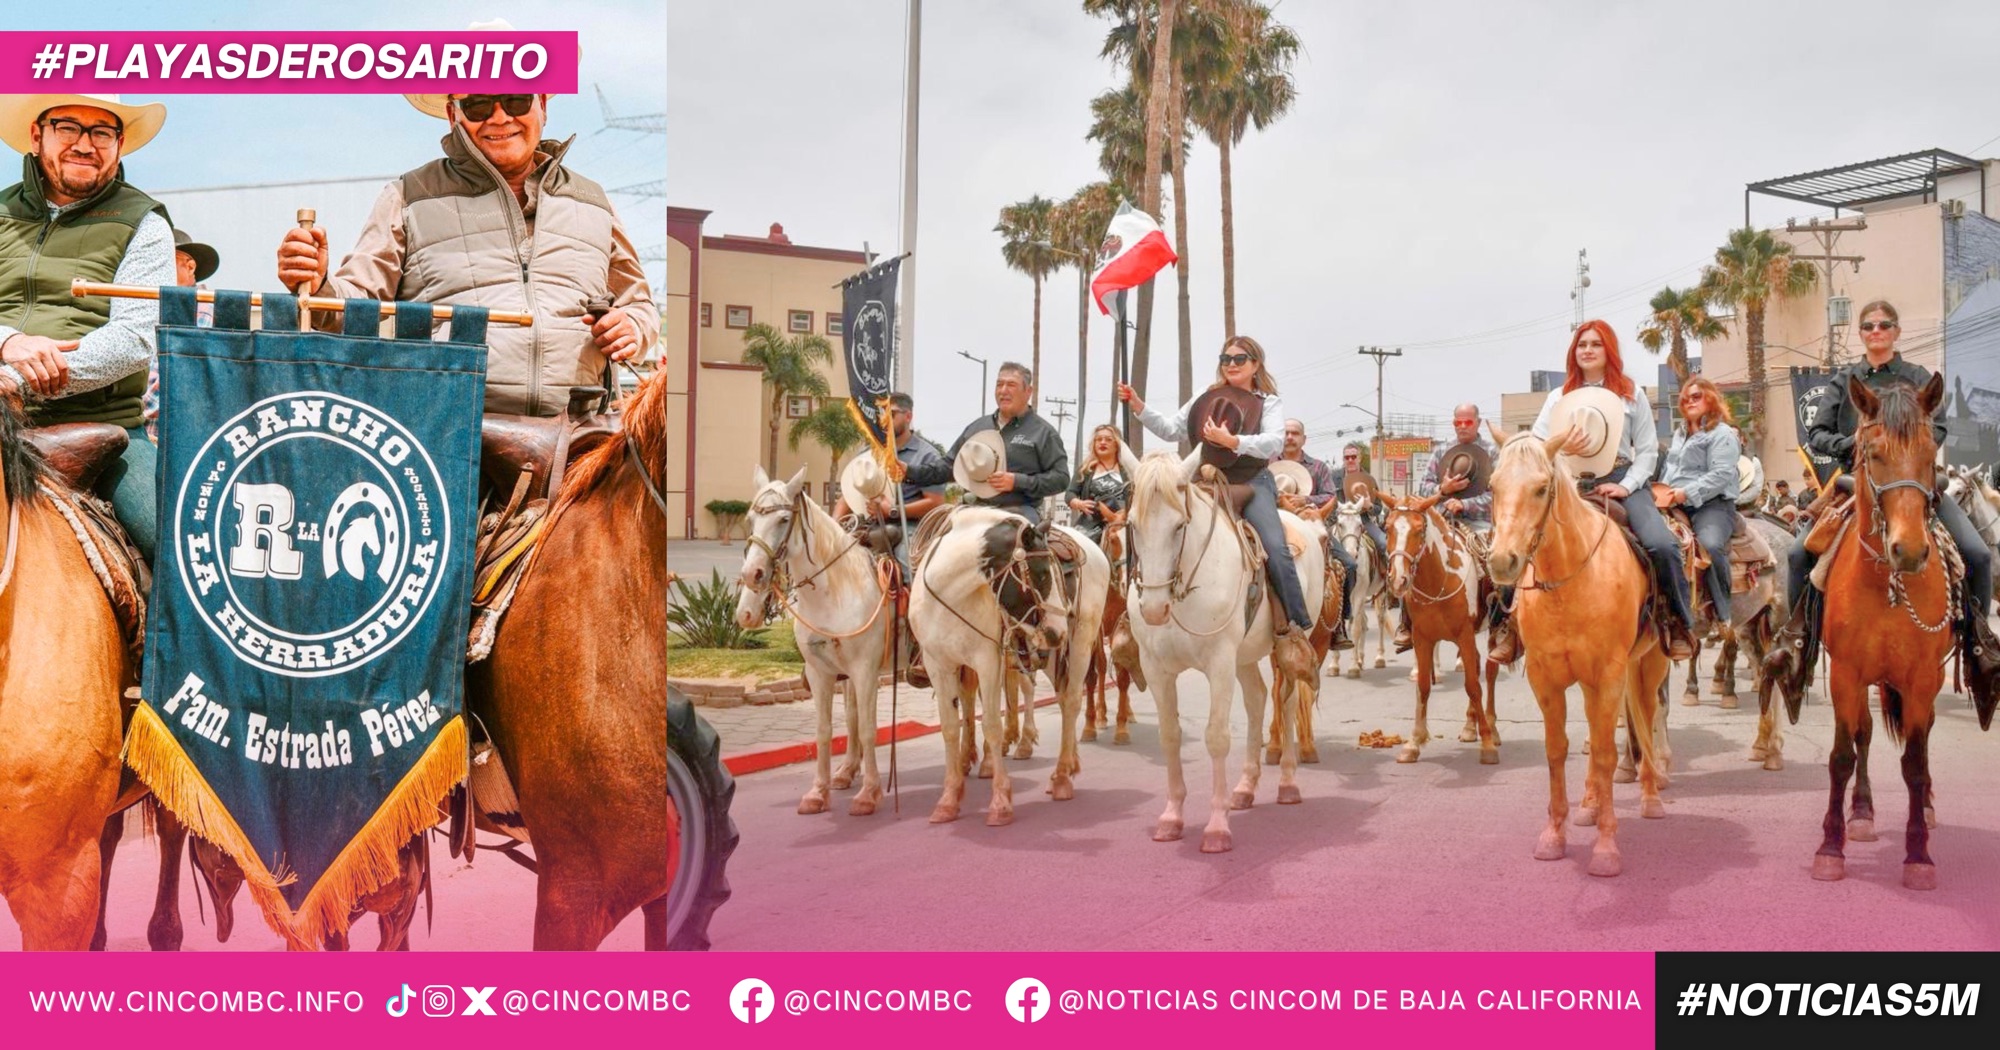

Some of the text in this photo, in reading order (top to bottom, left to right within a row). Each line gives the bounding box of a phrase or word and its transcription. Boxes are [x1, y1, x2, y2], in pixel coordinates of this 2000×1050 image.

[224, 400, 411, 467] RANCHO
[231, 482, 320, 580] R LA
[404, 467, 432, 536] ROSARITO
[187, 532, 438, 668] LA HERRADURA
[163, 671, 441, 769] Fam. Estrada Pérez
